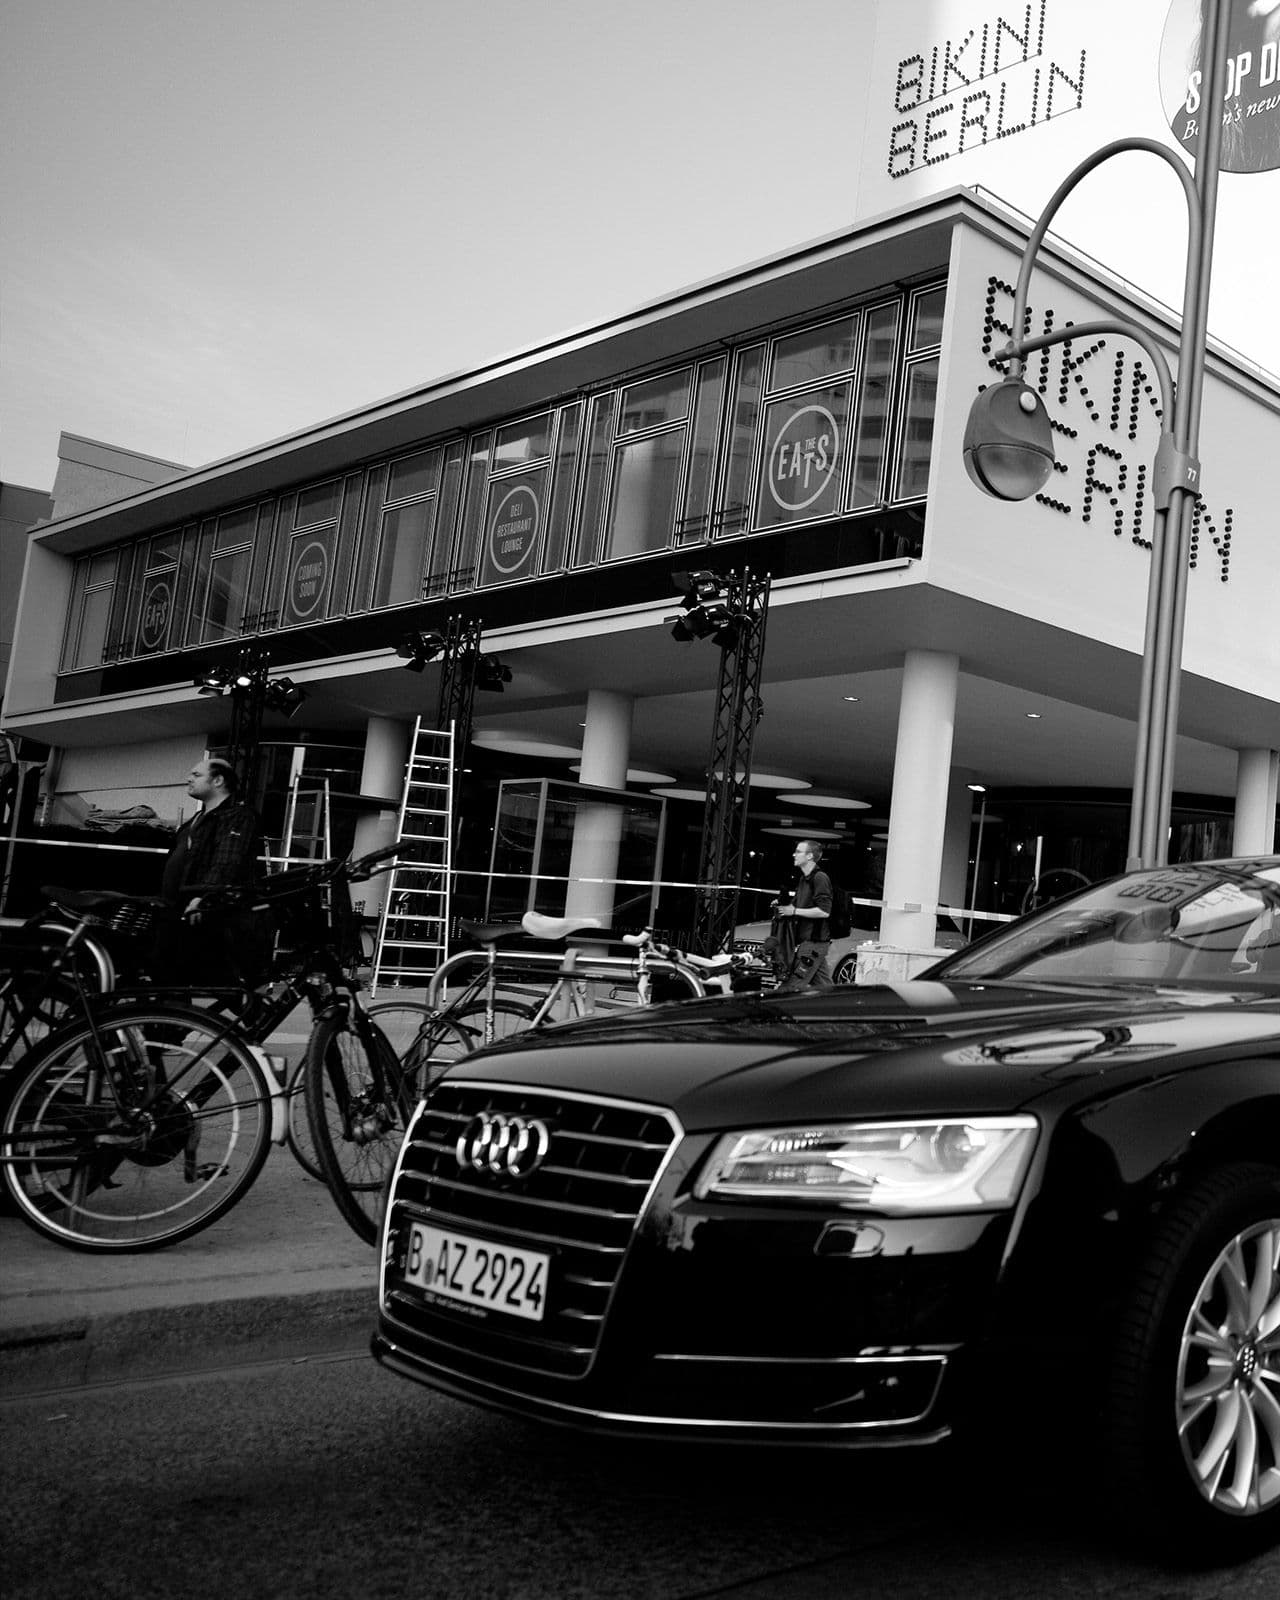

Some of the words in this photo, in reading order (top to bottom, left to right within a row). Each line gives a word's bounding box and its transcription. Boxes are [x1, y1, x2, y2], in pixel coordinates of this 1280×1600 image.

[895, 0, 1047, 113] BIKINI
[887, 49, 1086, 178] BERLIN
[1246, 93, 1280, 118] new
[777, 434, 829, 489] EATS
[497, 517, 532, 538] RESTAURANT
[510, 503, 523, 518] DELI
[501, 537, 524, 554] LOUNGE
[409, 1229, 424, 1276] B
[434, 1238, 468, 1292] AZ
[470, 1247, 543, 1312] 2924
